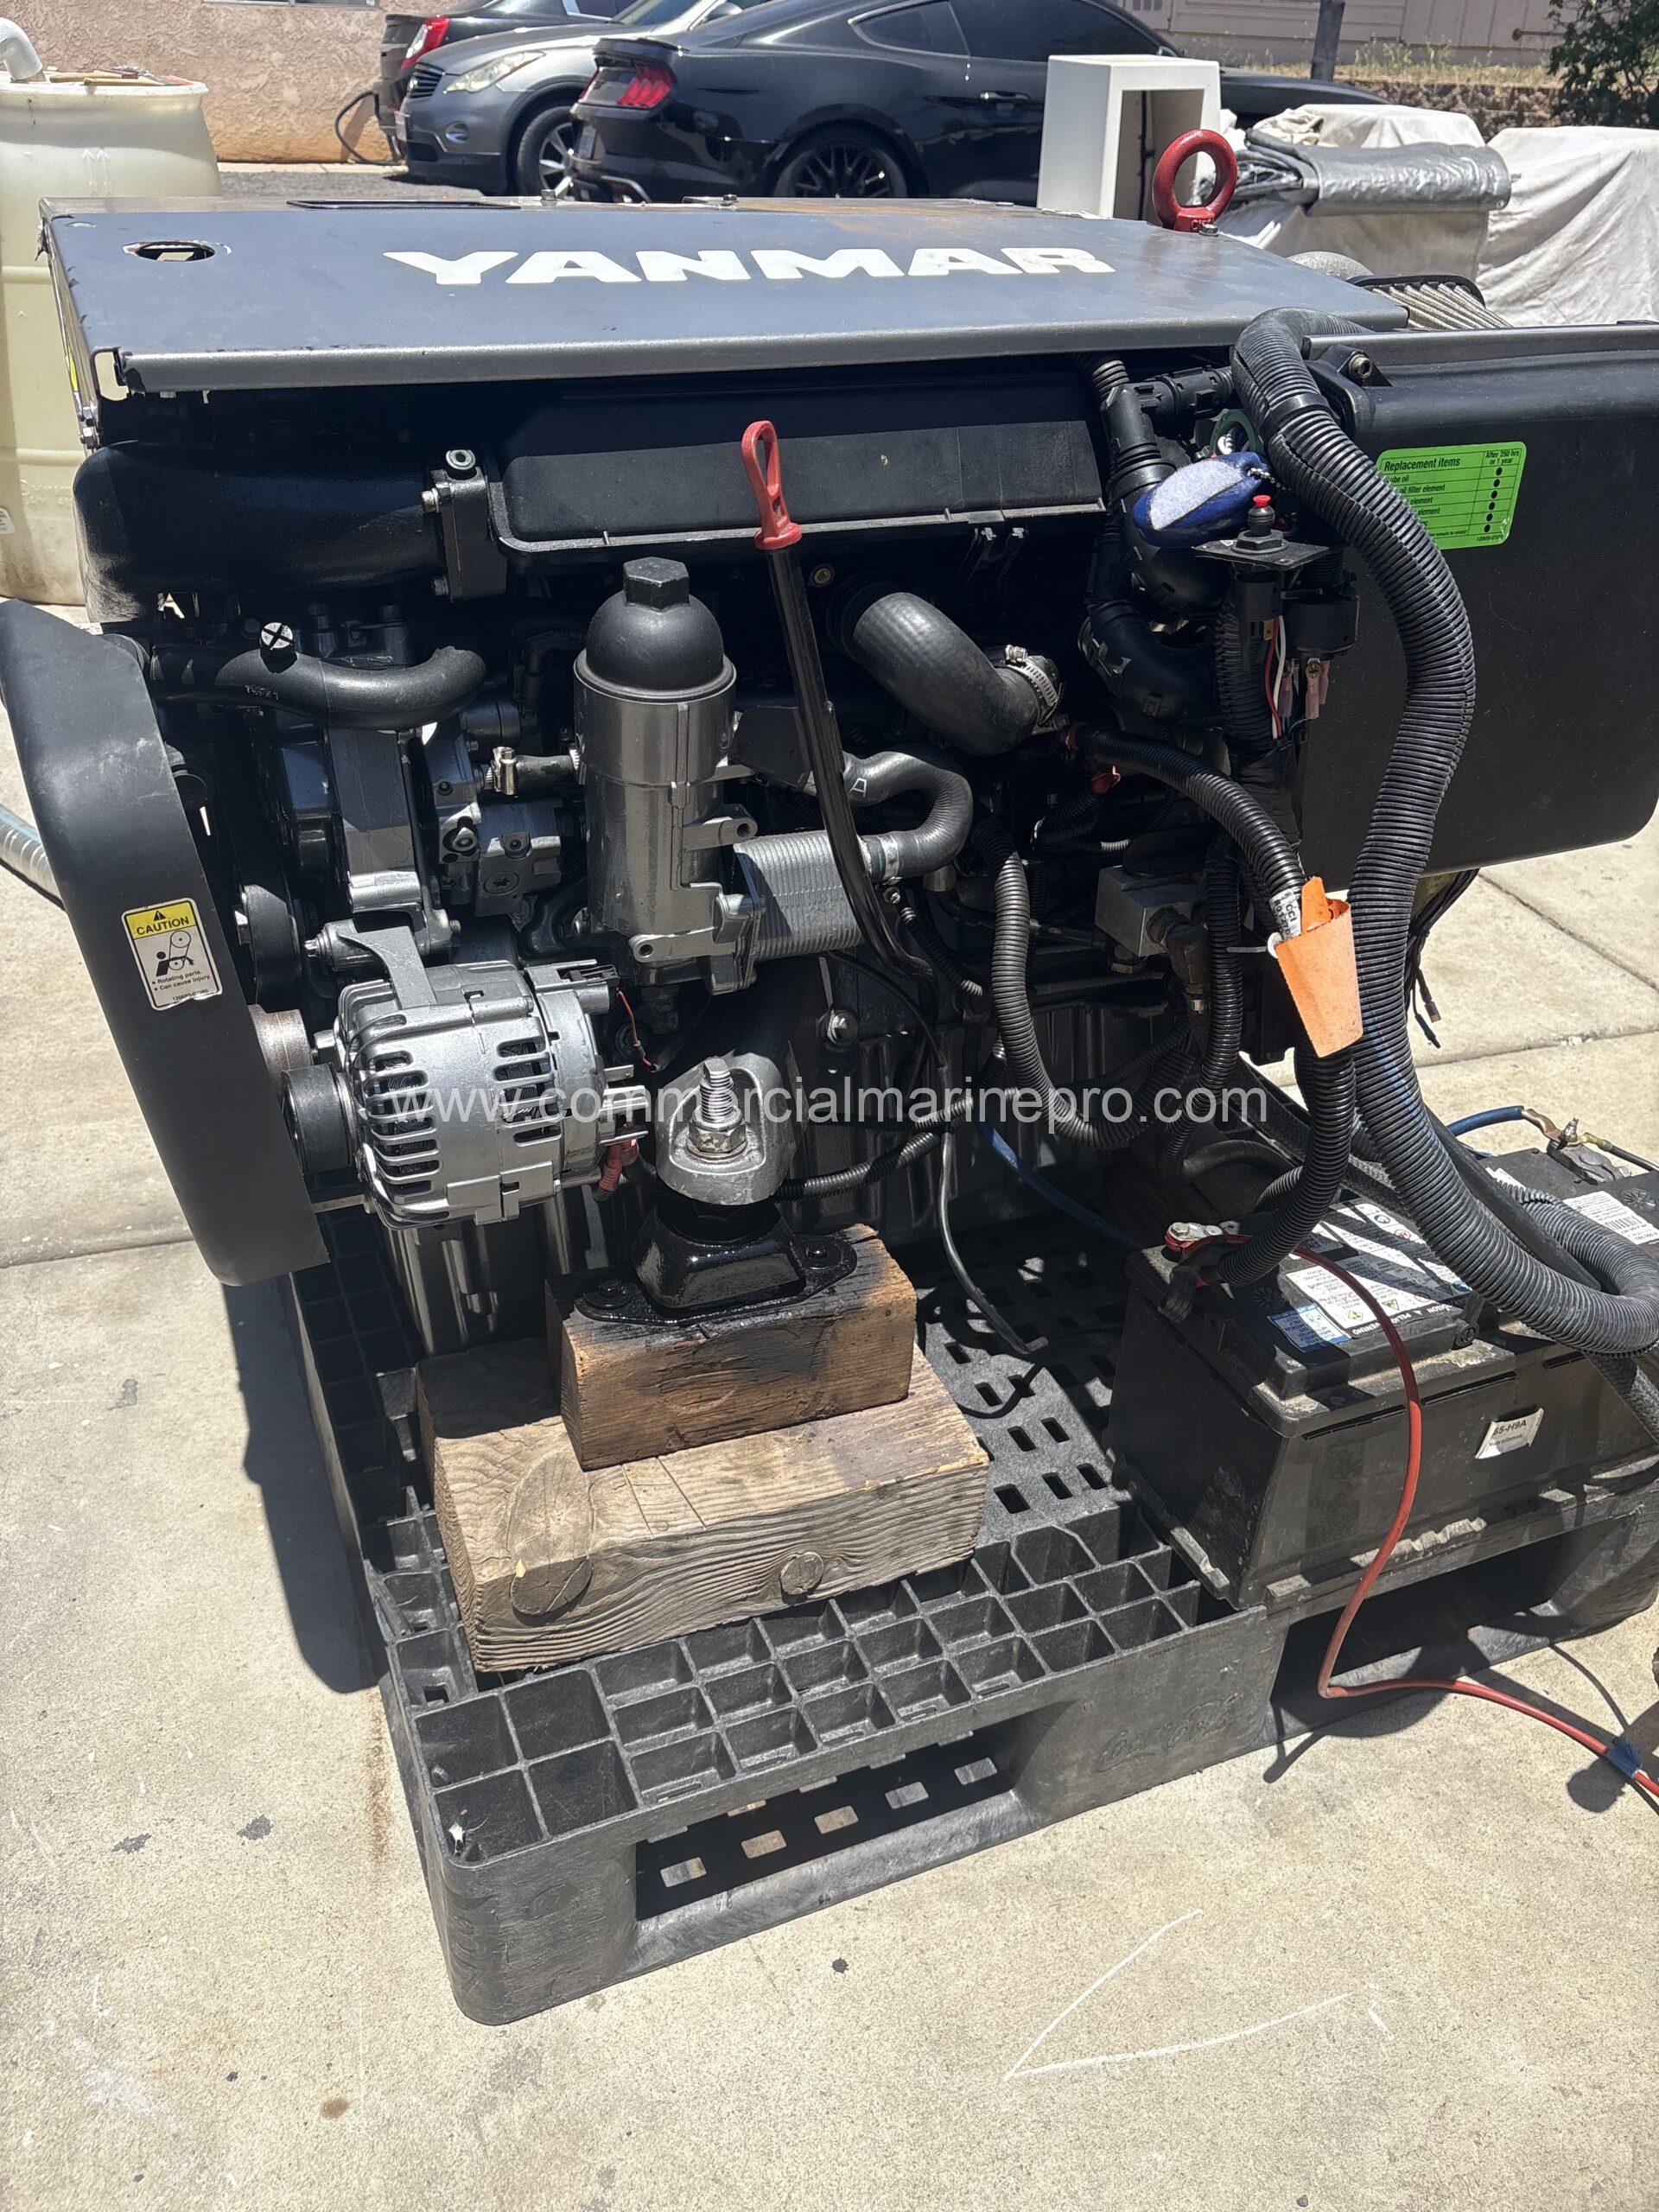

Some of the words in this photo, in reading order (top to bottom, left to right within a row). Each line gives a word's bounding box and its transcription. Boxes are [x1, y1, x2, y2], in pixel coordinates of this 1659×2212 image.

[383, 248, 1116, 284] YANMAR
[1384, 461, 1437, 473] Replacement
[1438, 458, 1461, 467] items
[1410, 496, 1433, 505] element
[137, 916, 189, 935] CAUTION
[157, 975, 183, 983] Rotating
